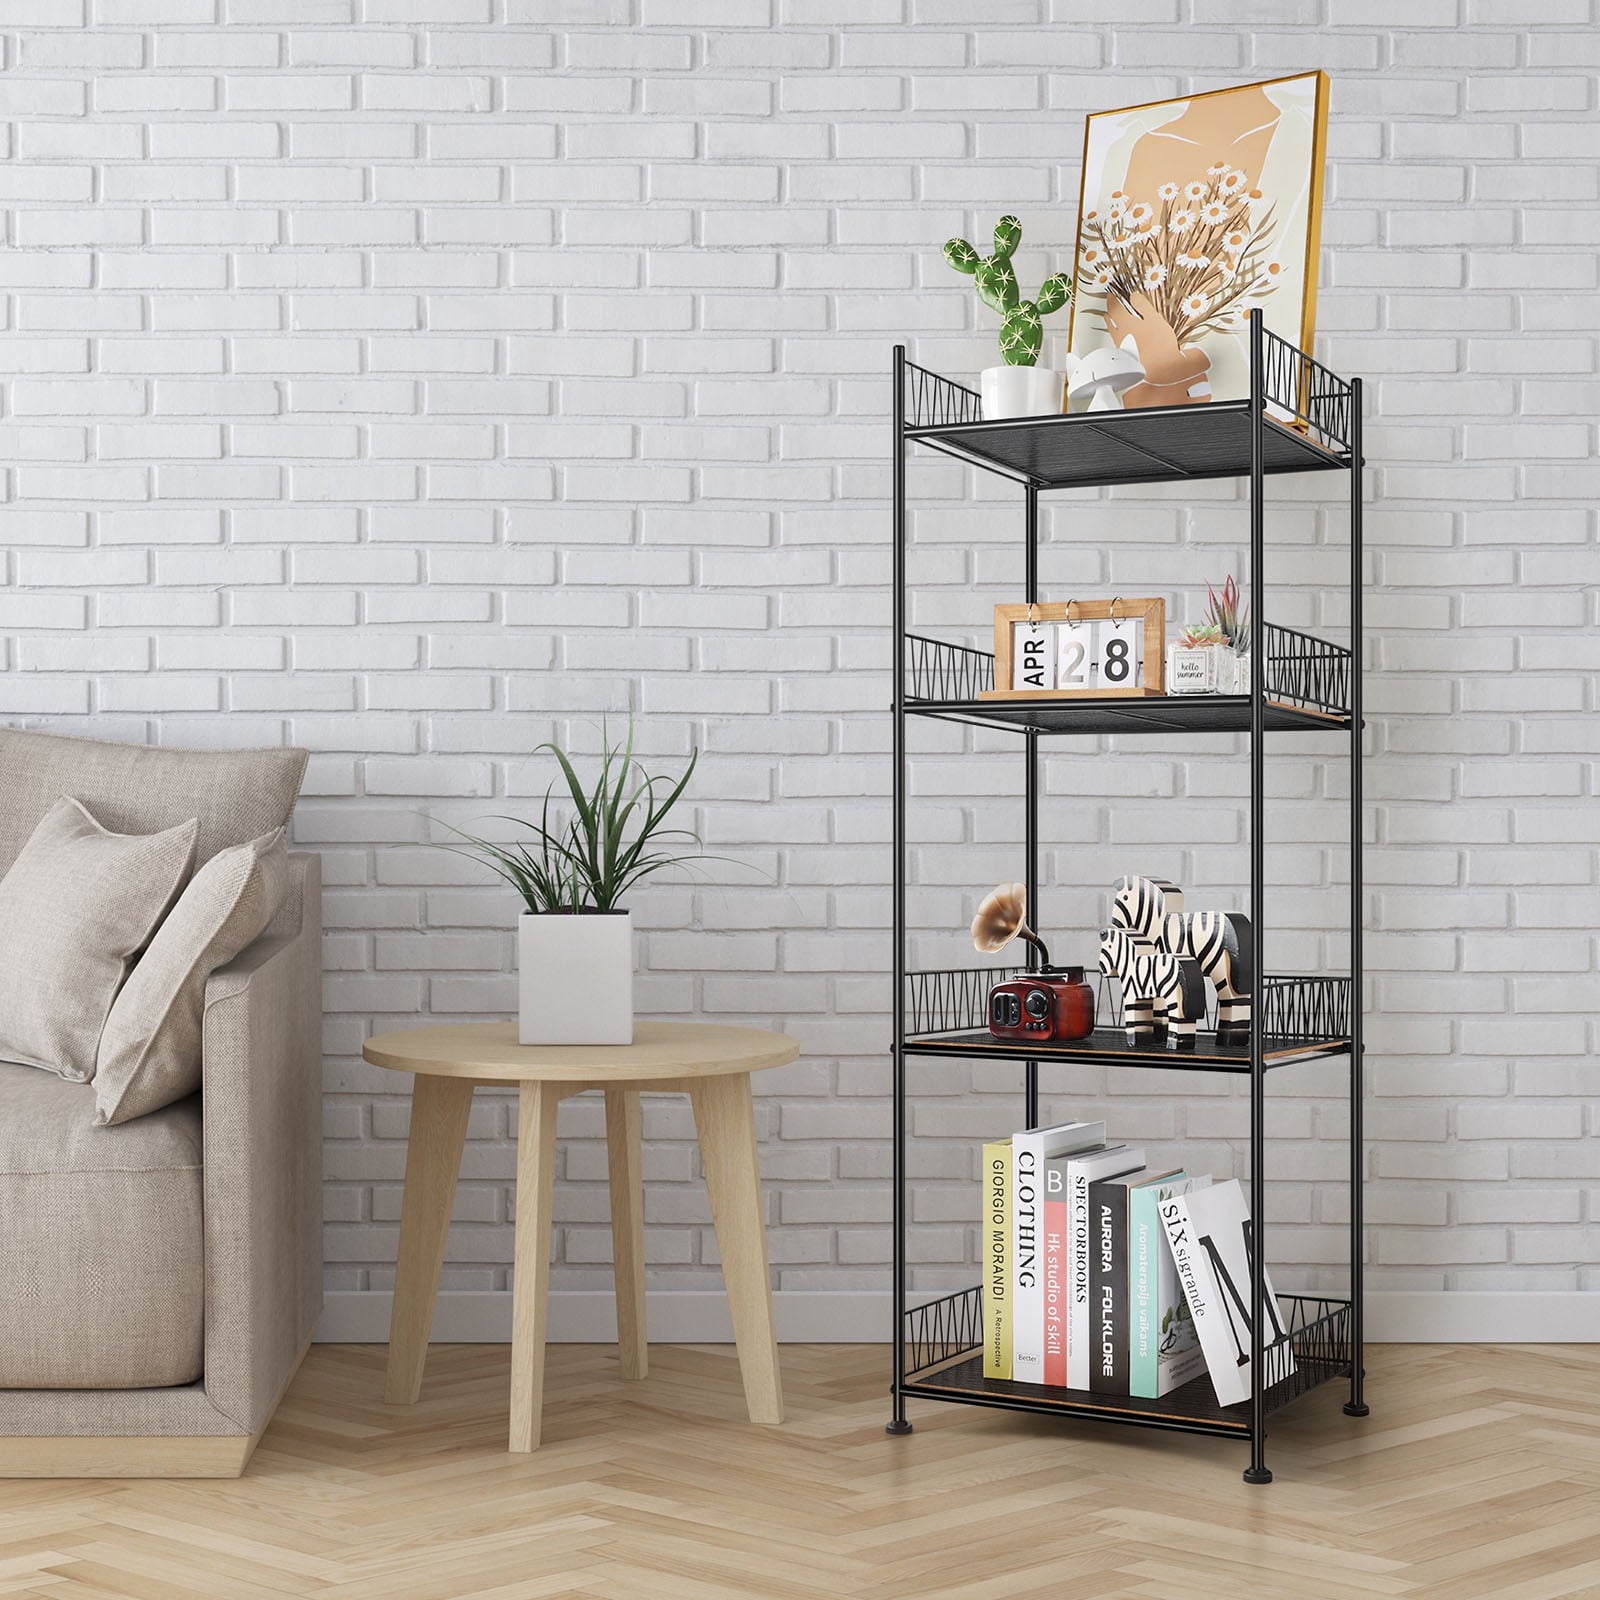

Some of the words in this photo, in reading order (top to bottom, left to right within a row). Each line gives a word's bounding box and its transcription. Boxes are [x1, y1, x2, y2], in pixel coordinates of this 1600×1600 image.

[1024, 639, 1045, 687] APR
[1104, 638, 1129, 682] 8
[1177, 671, 1204, 680] summer
[1181, 662, 1199, 671] hello
[992, 1160, 1004, 1225] GIORGIO
[1048, 1171, 1062, 1192] B
[1018, 1151, 1035, 1289] CLOTHING
[1048, 1233, 1060, 1253] Hk
[1076, 1175, 1086, 1303] SPECTORBOOKS
[1101, 1205, 1112, 1272] AURORA
[993, 1231, 1004, 1300] MORANDI
[1048, 1257, 1060, 1303] studio
[1162, 1204, 1188, 1247] six
[1177, 1248, 1206, 1317] sigrande
[1048, 1306, 1060, 1322] of
[1102, 1286, 1113, 1376] FOLKLORE
[994, 1317, 1002, 1367] Retrospective
[1048, 1325, 1060, 1354] skill
